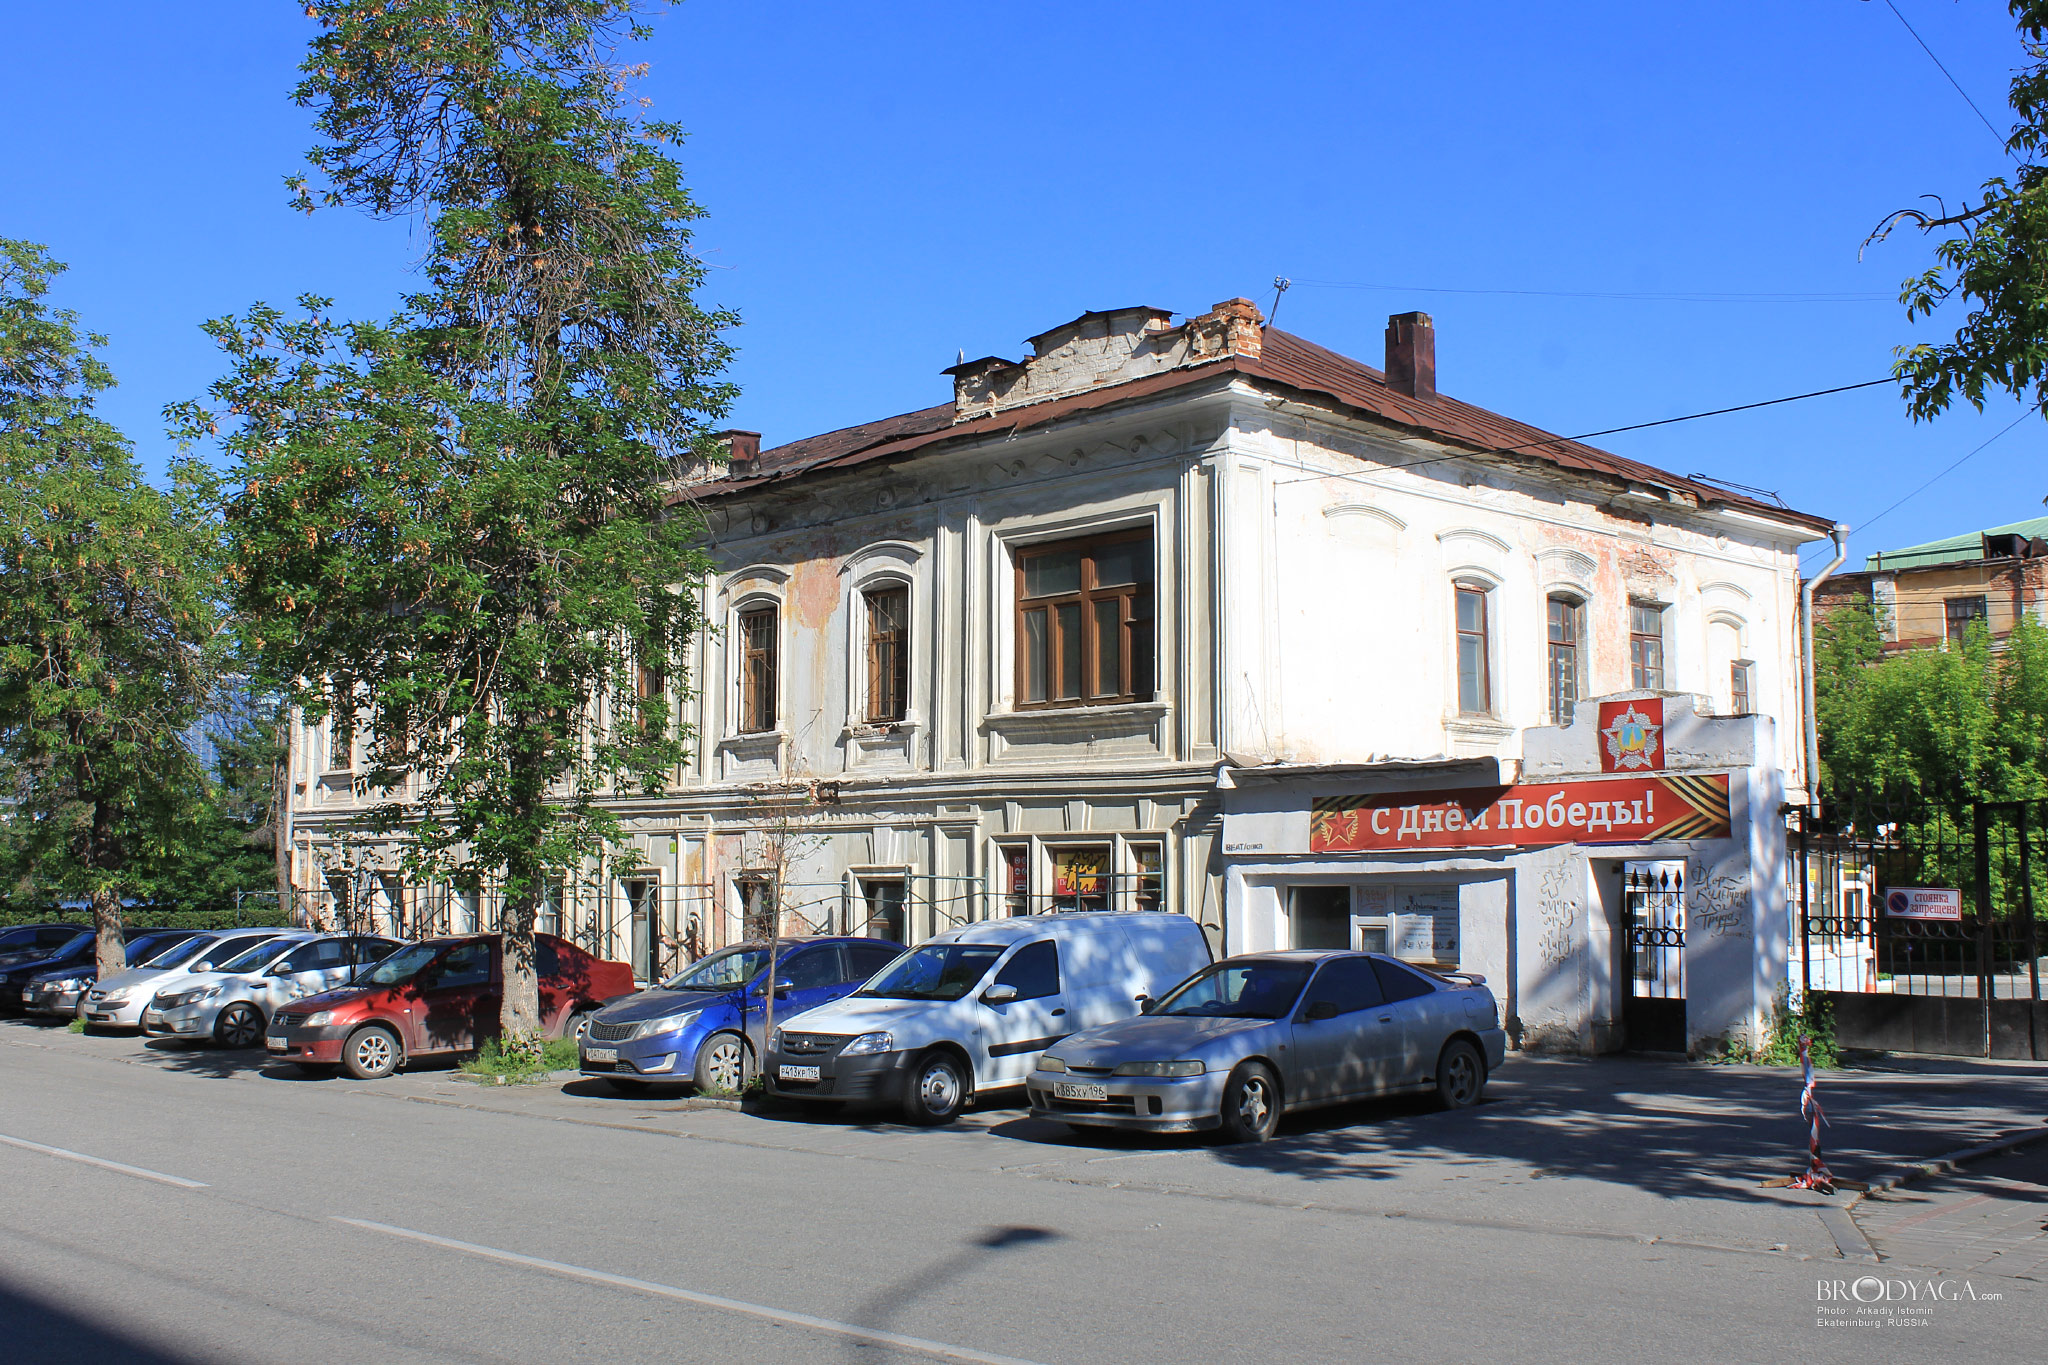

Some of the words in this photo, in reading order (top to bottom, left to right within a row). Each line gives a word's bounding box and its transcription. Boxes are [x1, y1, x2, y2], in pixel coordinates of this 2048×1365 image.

[1397, 800, 1489, 841] Днём
[1497, 790, 1654, 833] Победы!
[1914, 893, 1949, 904] стоянка
[1909, 903, 1957, 917] запрещена
